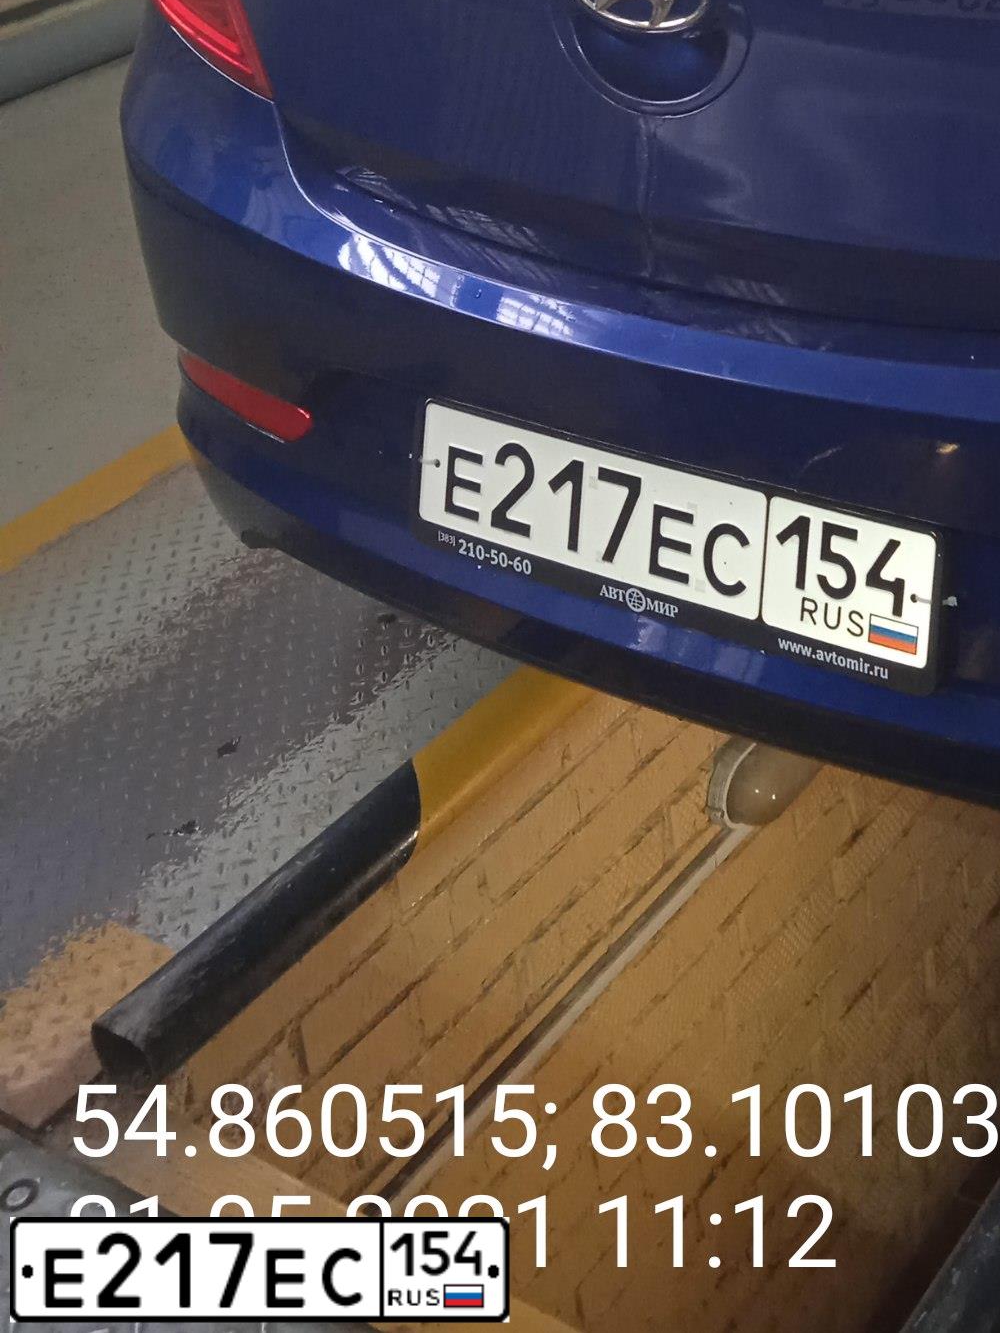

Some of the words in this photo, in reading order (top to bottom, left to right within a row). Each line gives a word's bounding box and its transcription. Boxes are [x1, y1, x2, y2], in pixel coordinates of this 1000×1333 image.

[445, 442, 751, 596] Е217ЕС
[775, 514, 906, 618] 154
[457, 538, 532, 576] 210-50-60
[799, 596, 865, 638] RUS
[777, 637, 889, 680] www.avtomir.ru
